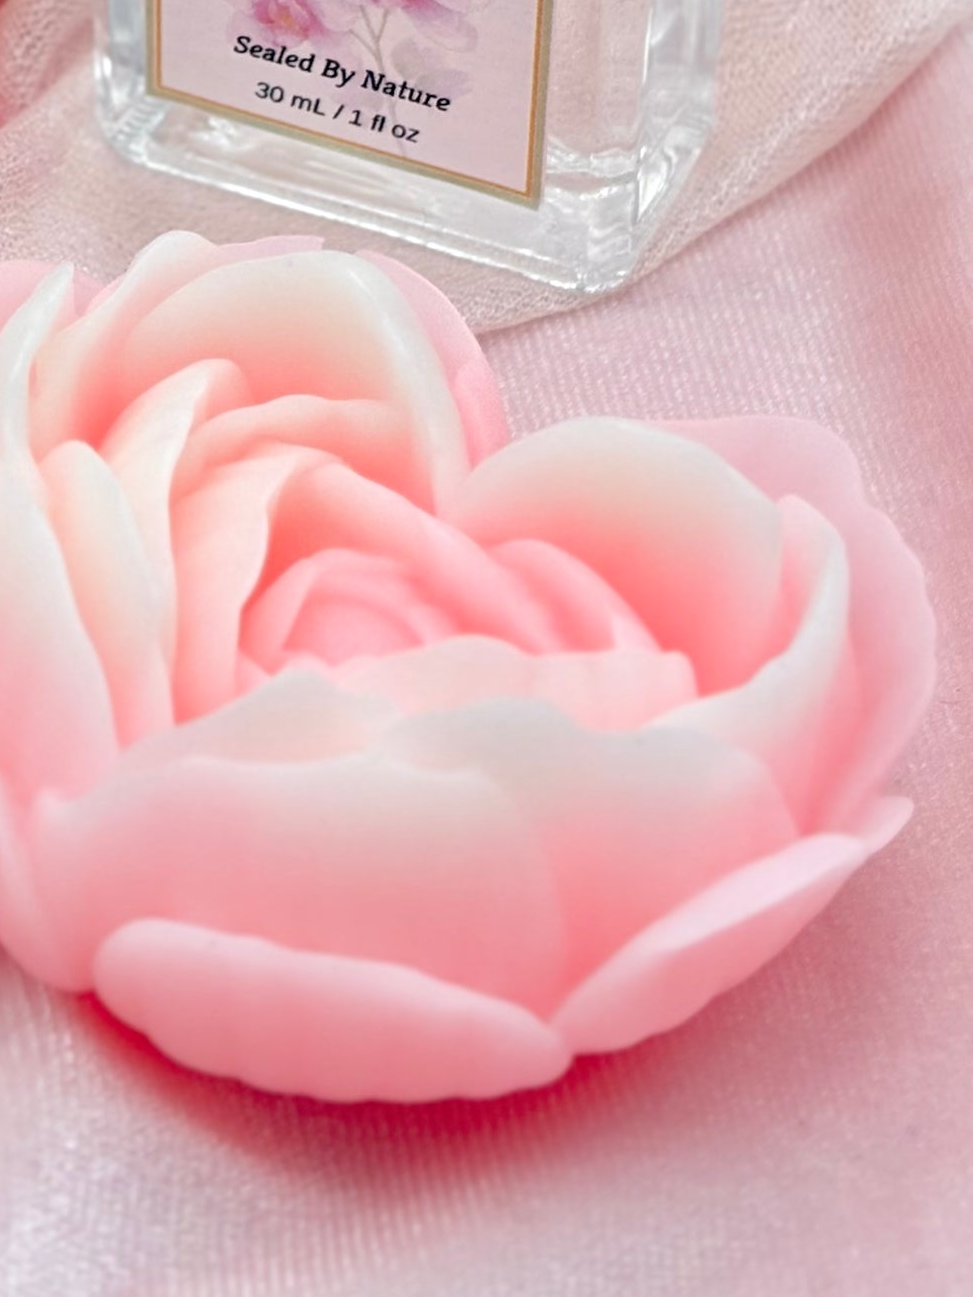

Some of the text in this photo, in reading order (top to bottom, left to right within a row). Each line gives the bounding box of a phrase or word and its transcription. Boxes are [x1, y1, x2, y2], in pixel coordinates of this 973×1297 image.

[233, 35, 451, 112] Sealed By Nature
[255, 81, 420, 144] 30 mL / 1 fl oz
